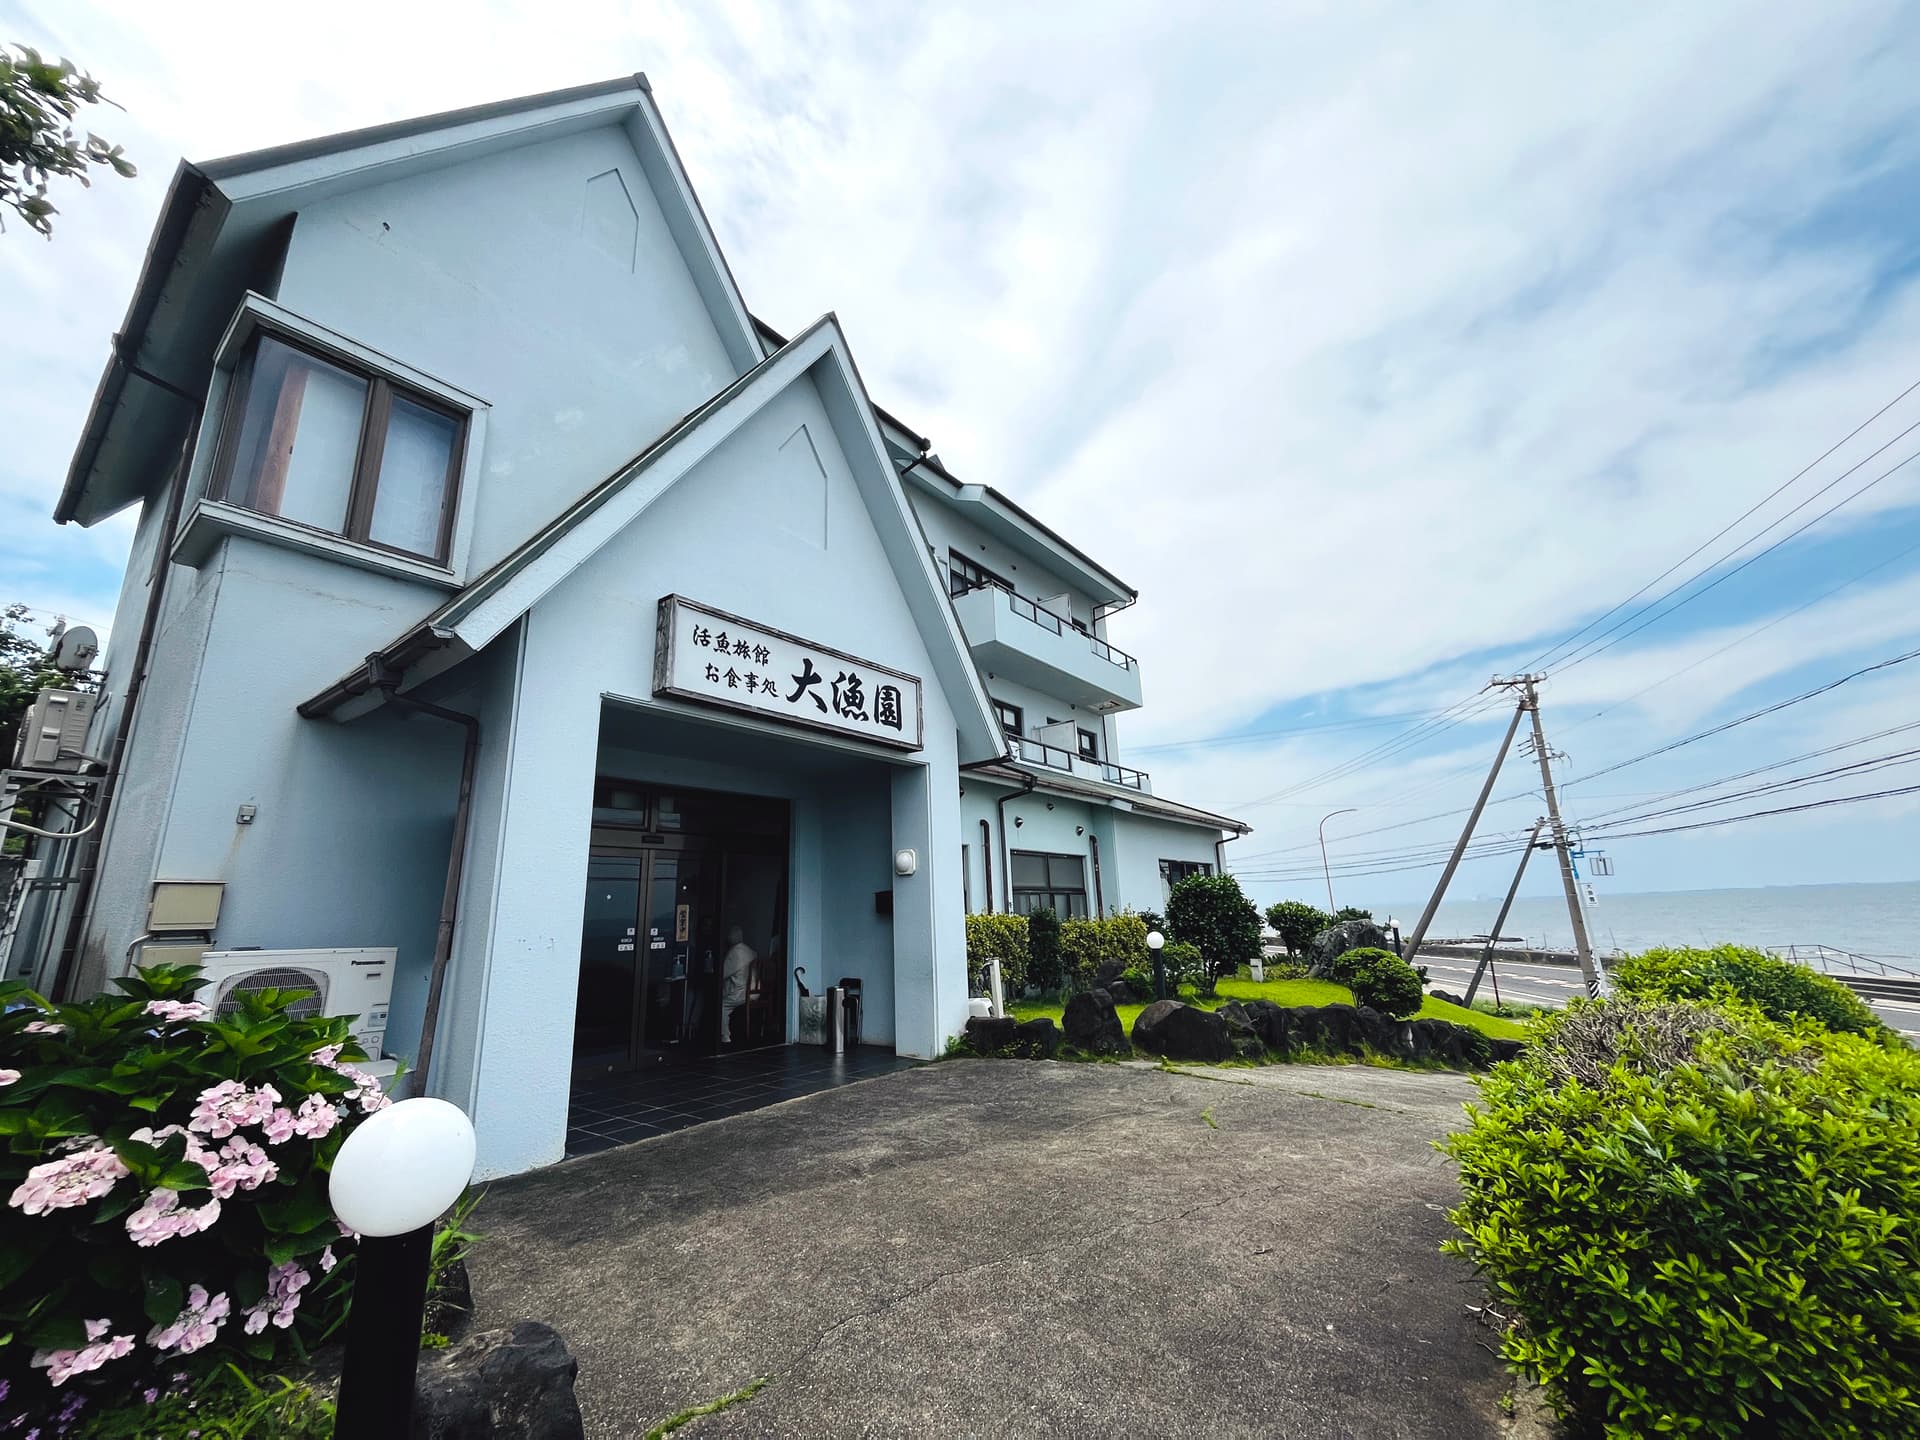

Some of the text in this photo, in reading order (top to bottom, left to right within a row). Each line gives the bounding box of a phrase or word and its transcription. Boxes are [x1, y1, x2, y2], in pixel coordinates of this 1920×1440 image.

[693, 624, 770, 666] 活魚旅館
[704, 662, 779, 698] お食事処
[786, 658, 902, 731] 大漁園
